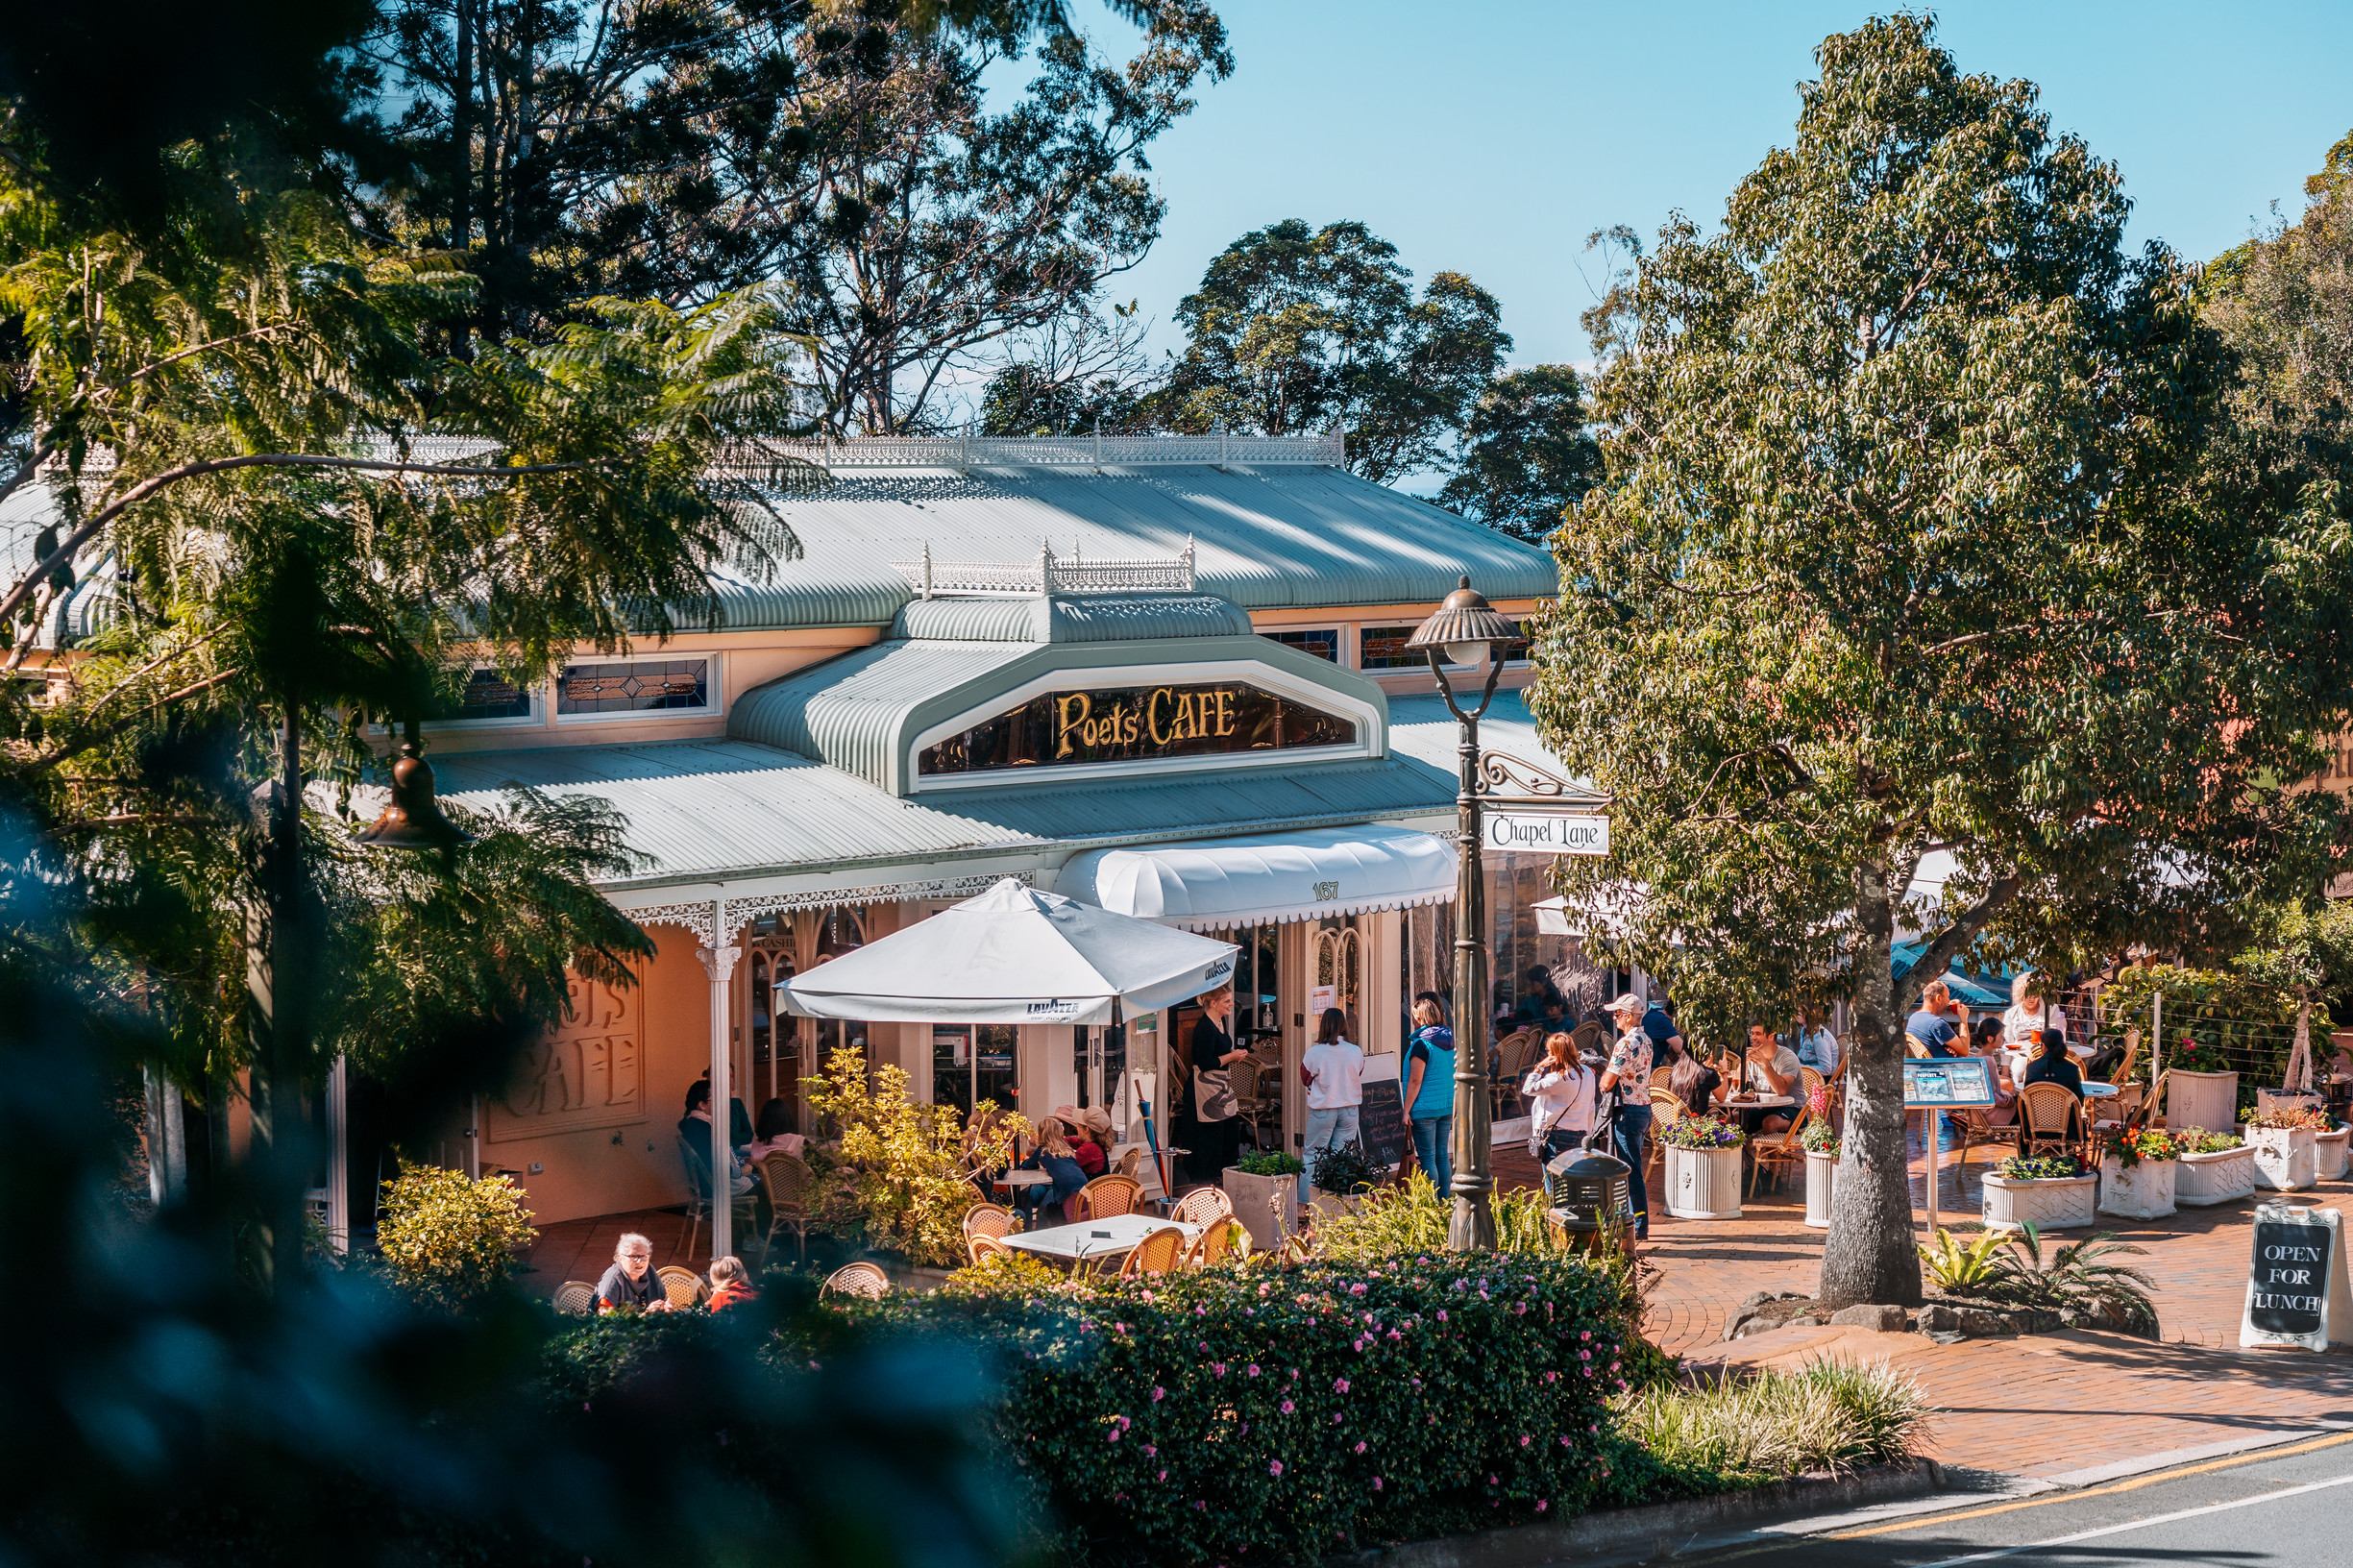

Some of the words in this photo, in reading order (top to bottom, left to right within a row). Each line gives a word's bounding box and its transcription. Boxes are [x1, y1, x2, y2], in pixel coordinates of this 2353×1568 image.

[1147, 687, 1236, 746] CAFE
[1492, 817, 1553, 847] Chapel
[1558, 819, 1600, 849] Lane
[1312, 881, 1339, 901] 167
[1027, 999, 1079, 1015] LAVAZZA
[2265, 1245, 2321, 1262] OPEN
[2267, 1268, 2312, 1285] FOR
[2255, 1292, 2320, 1311] LUNCH
